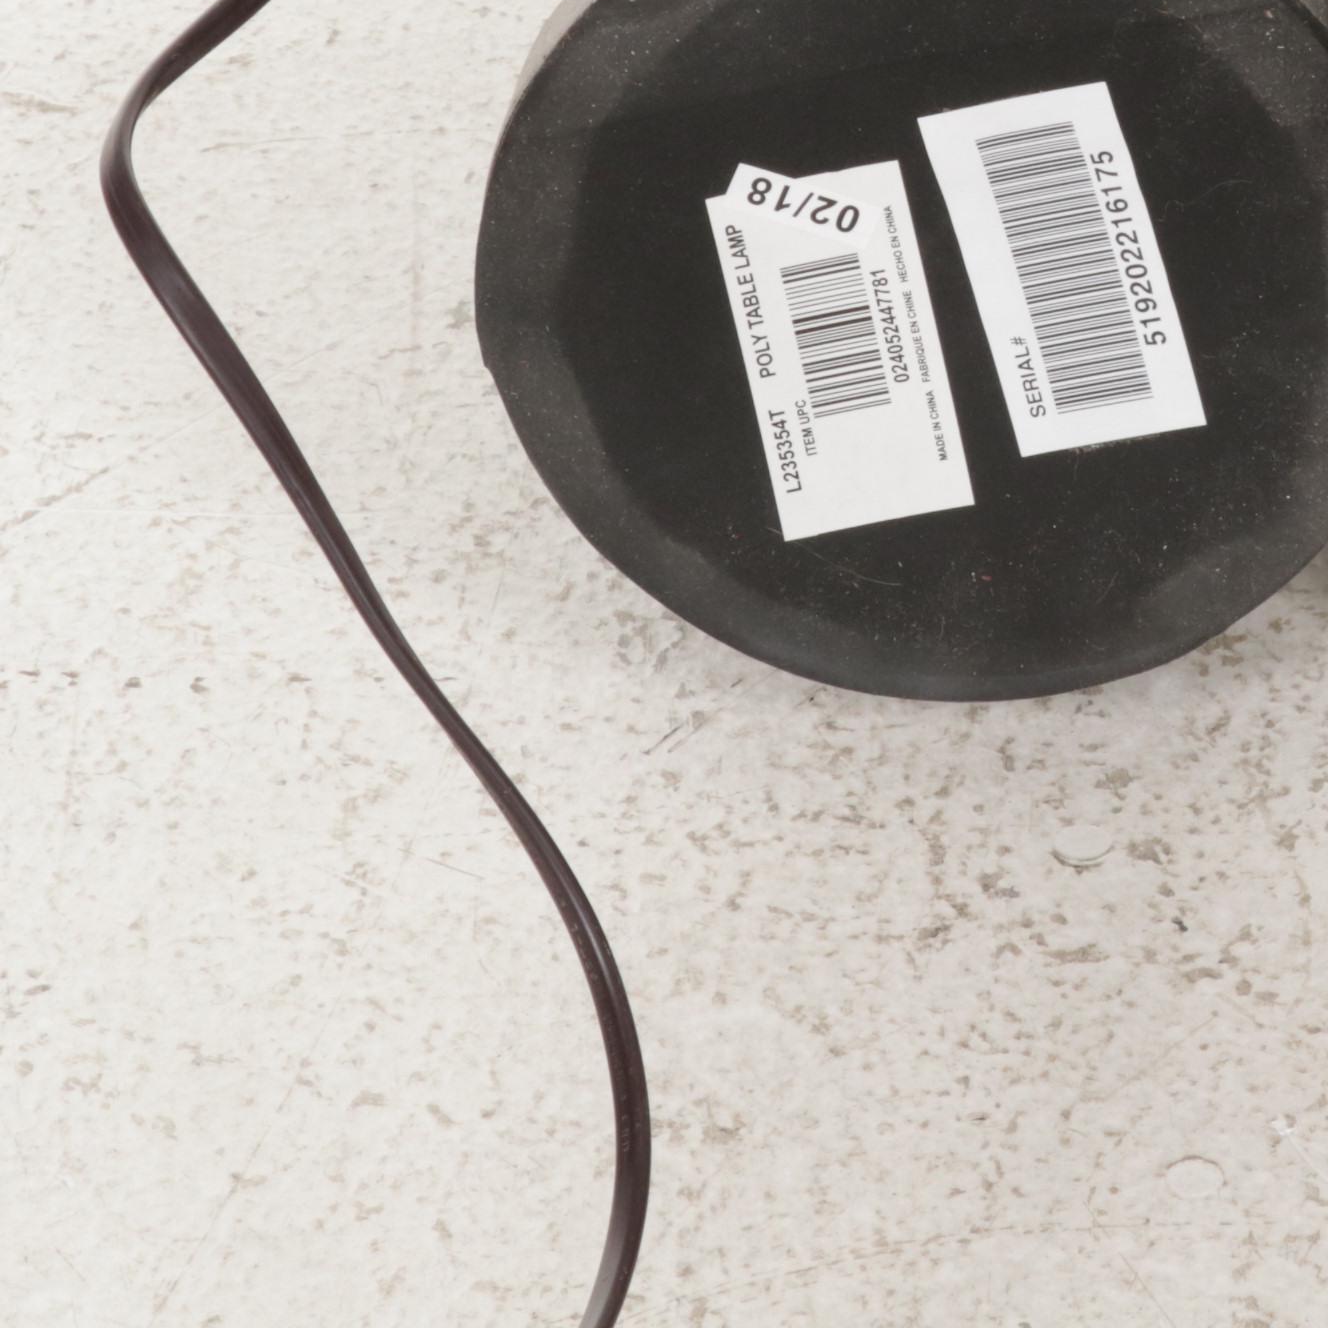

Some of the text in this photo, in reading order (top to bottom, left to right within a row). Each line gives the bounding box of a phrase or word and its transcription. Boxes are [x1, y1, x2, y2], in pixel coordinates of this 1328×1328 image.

[746, 177, 860, 233] 02/18
[1089, 150, 1167, 346] 519202216175
[724, 224, 777, 379] POLY TABLE LAMP
[869, 269, 910, 383] 024052447781
[883, 205, 948, 462] MADE IN CHINA FABRIQUE EN CHINE HECHO EN CHINA
[1010, 336, 1047, 418] SERIAL#
[767, 409, 803, 494] L235354T
[794, 399, 817, 457] ITEM UPC
